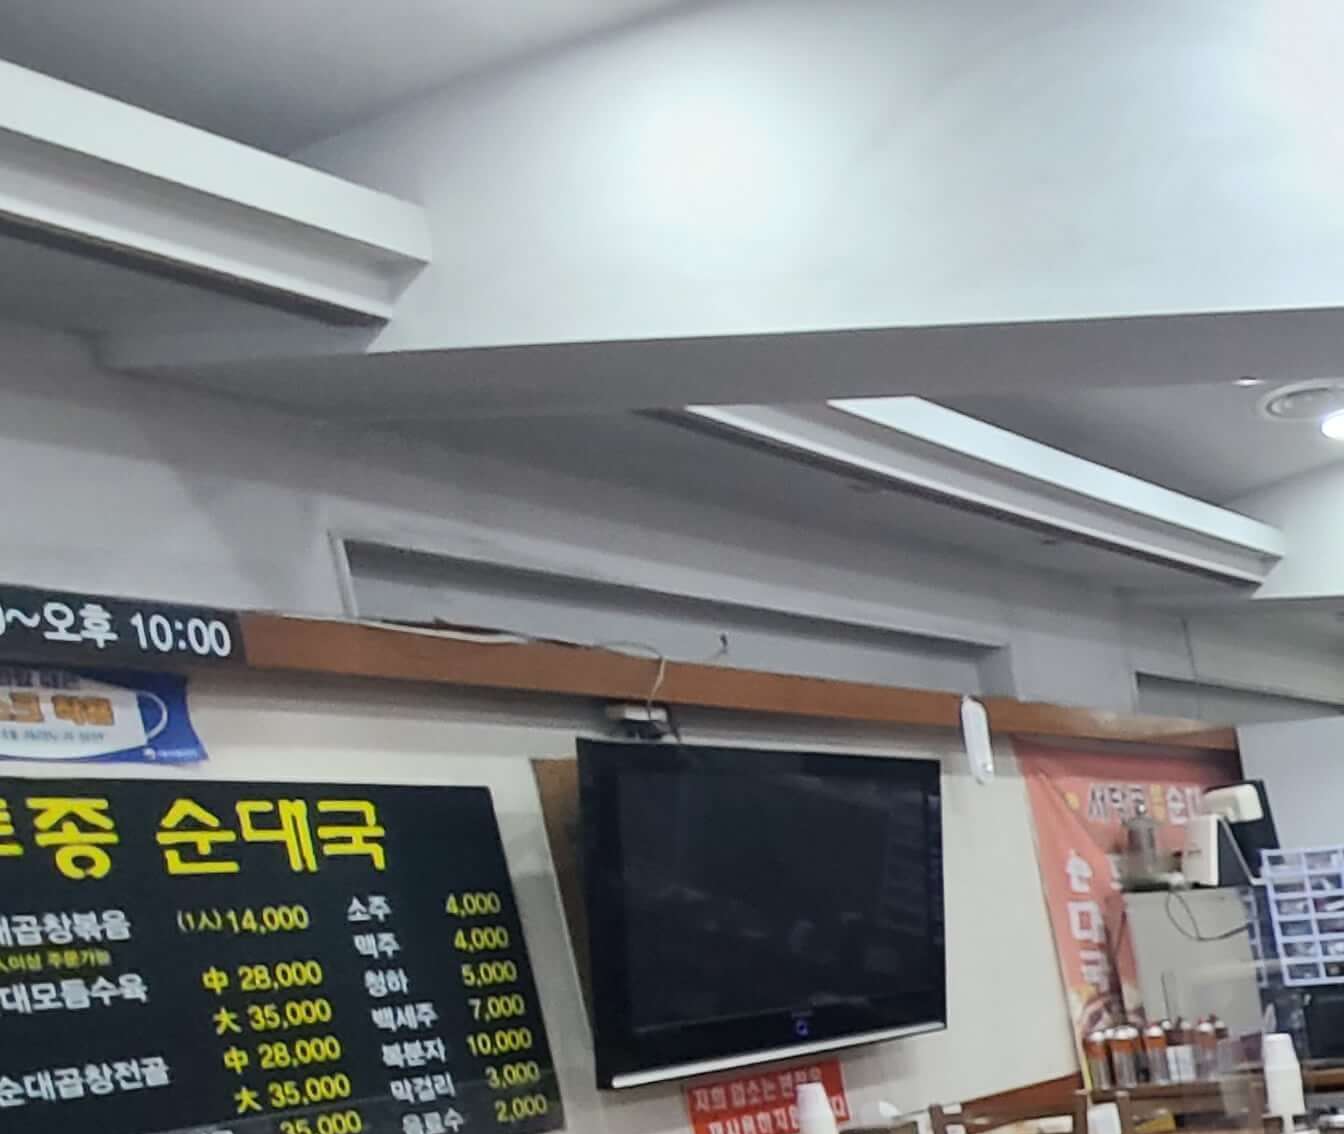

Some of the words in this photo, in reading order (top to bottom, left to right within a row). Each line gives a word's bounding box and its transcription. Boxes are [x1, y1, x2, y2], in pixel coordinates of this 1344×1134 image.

[0, 601, 118, 648] ~오후
[131, 611, 231, 657] 10:00
[155, 799, 386, 875] 순대국
[227, 904, 310, 935] 14,000
[347, 895, 392, 922] 소주
[446, 892, 501, 917] 4,000
[353, 932, 401, 959] 맥주
[453, 926, 509, 951] 4,000
[238, 960, 323, 991] 28,000
[461, 960, 518, 987] 5,000
[247, 998, 333, 1033] 35,000
[371, 1002, 439, 1032] 백세주
[468, 994, 526, 1021] 7,000
[257, 1035, 342, 1070] 28,000
[466, 1027, 533, 1057] 10,000
[390, 1072, 457, 1104] 막걸리
[486, 1060, 541, 1089] 3,000
[267, 1073, 353, 1109] 35,000
[495, 1094, 548, 1123] 2,000
